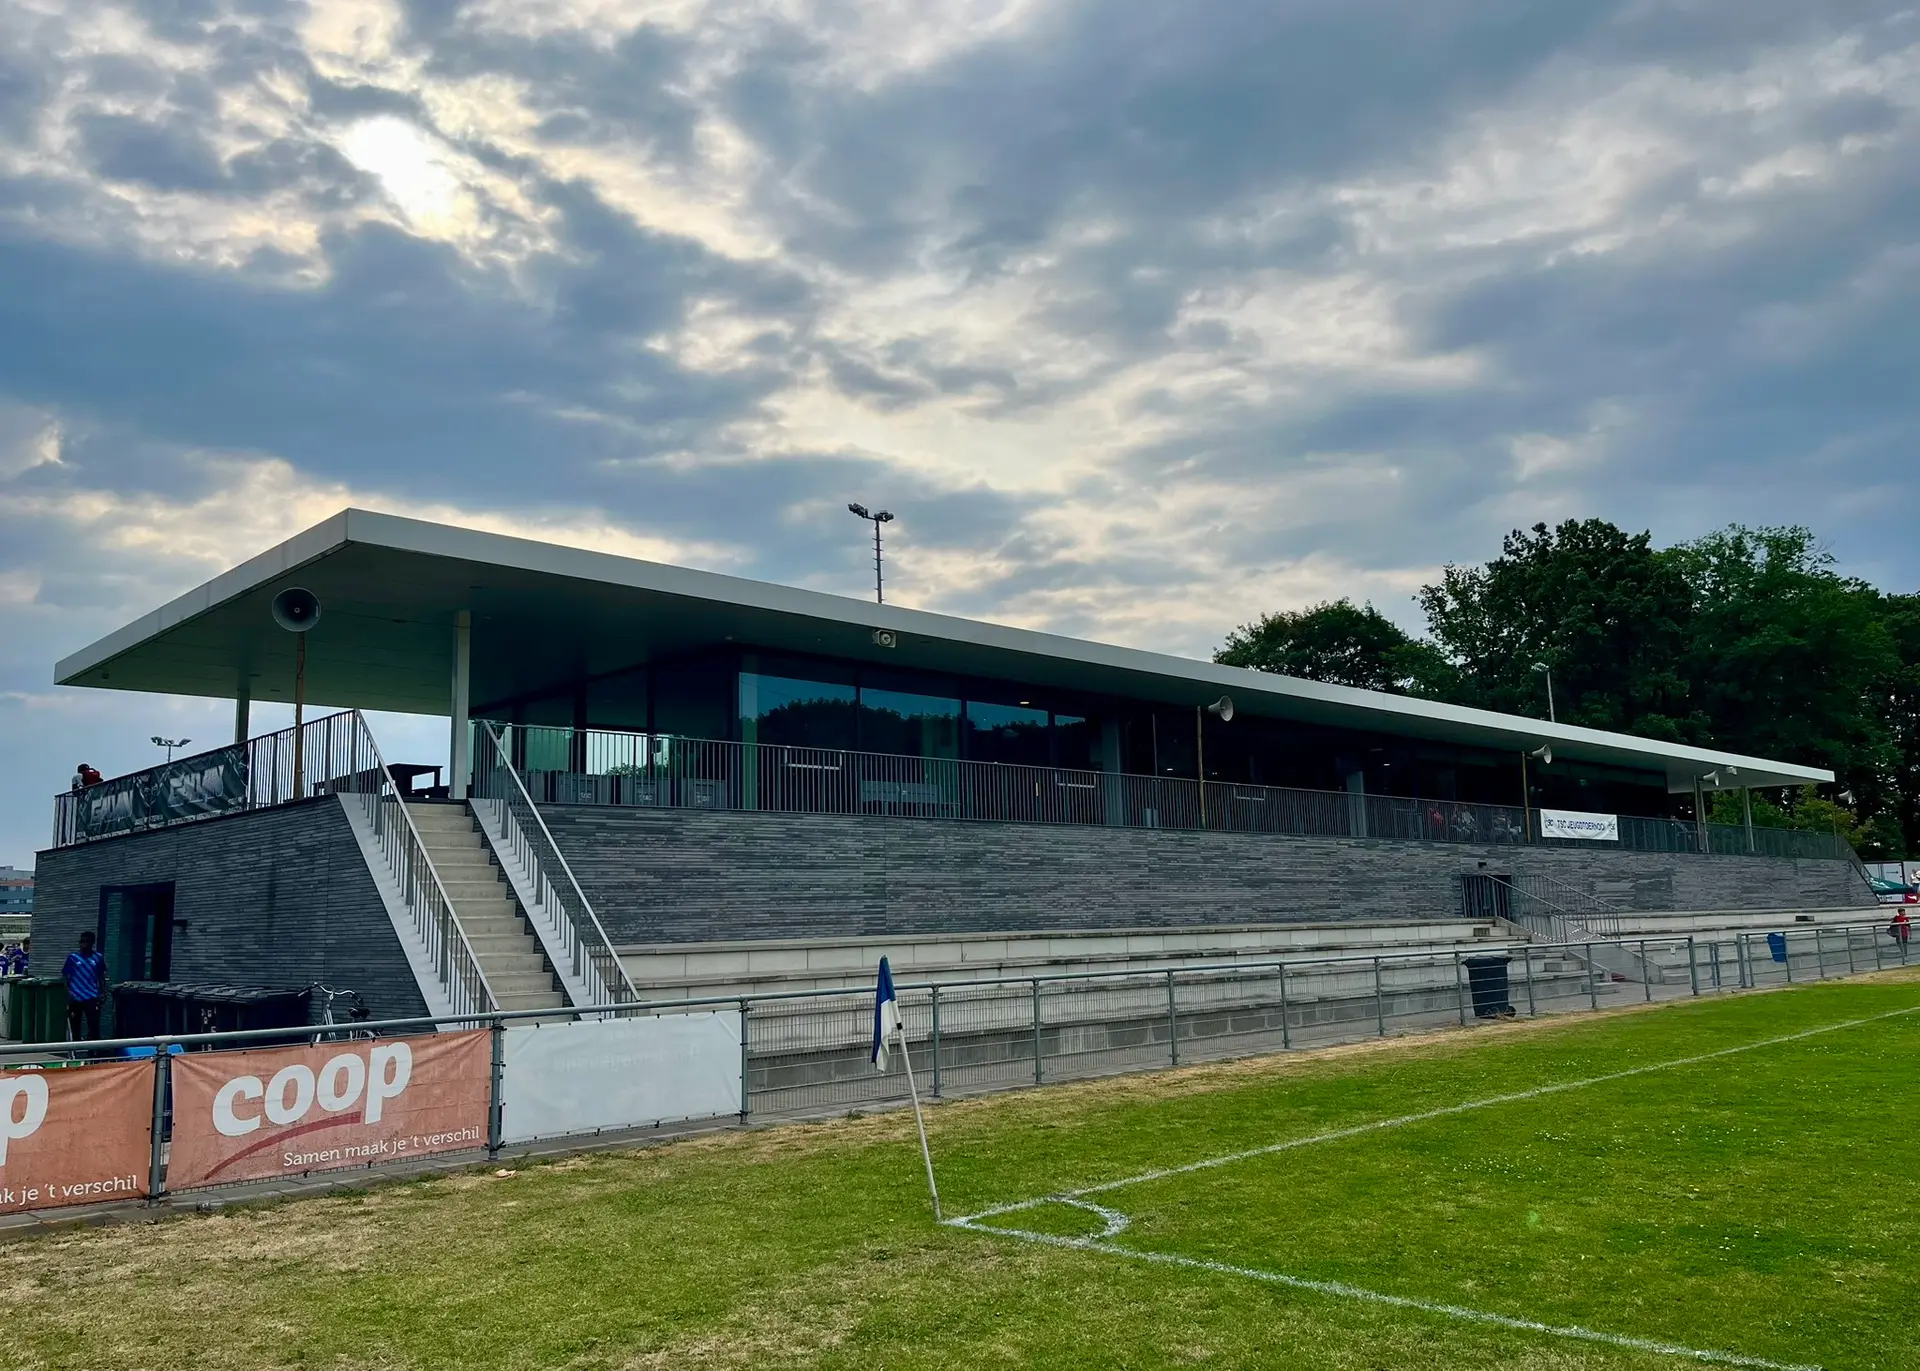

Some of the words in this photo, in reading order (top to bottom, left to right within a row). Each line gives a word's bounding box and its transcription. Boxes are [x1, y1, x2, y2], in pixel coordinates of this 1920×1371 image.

[212, 1041, 413, 1137] coop
[283, 1149, 340, 1167] Samen
[345, 1140, 388, 1157] maak
[391, 1138, 406, 1154] je
[423, 1126, 480, 1146] verschil
[0, 1188, 15, 1203] k
[19, 1186, 39, 1205] je
[62, 1175, 138, 1196] verschil
